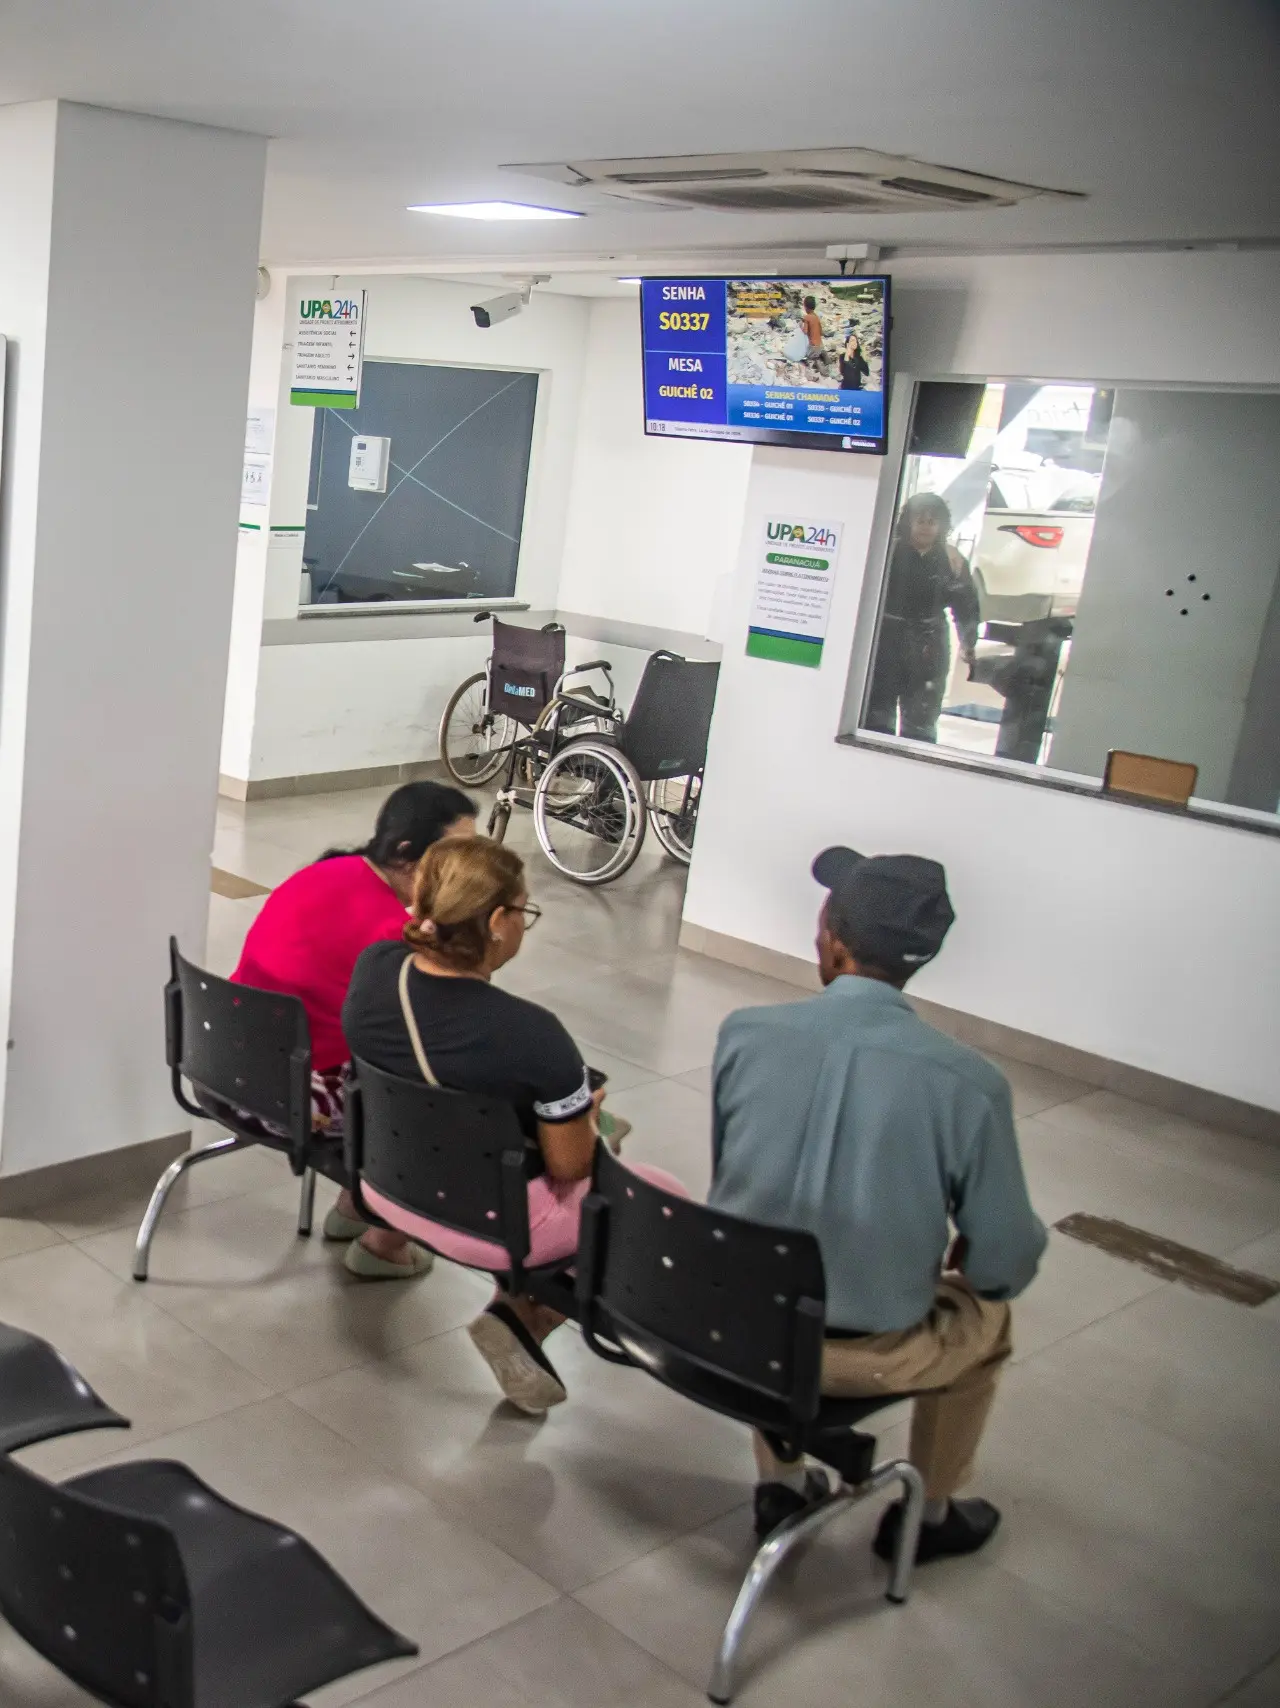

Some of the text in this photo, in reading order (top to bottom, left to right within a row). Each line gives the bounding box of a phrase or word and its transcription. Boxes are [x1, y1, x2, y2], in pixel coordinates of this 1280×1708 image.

[663, 287, 705, 300] SENHA
[659, 312, 710, 331] S0337
[668, 358, 703, 372] MESA
[659, 383, 713, 400] GUICHÊ 02
[765, 391, 840, 403] SENHAS CHAMADAS
